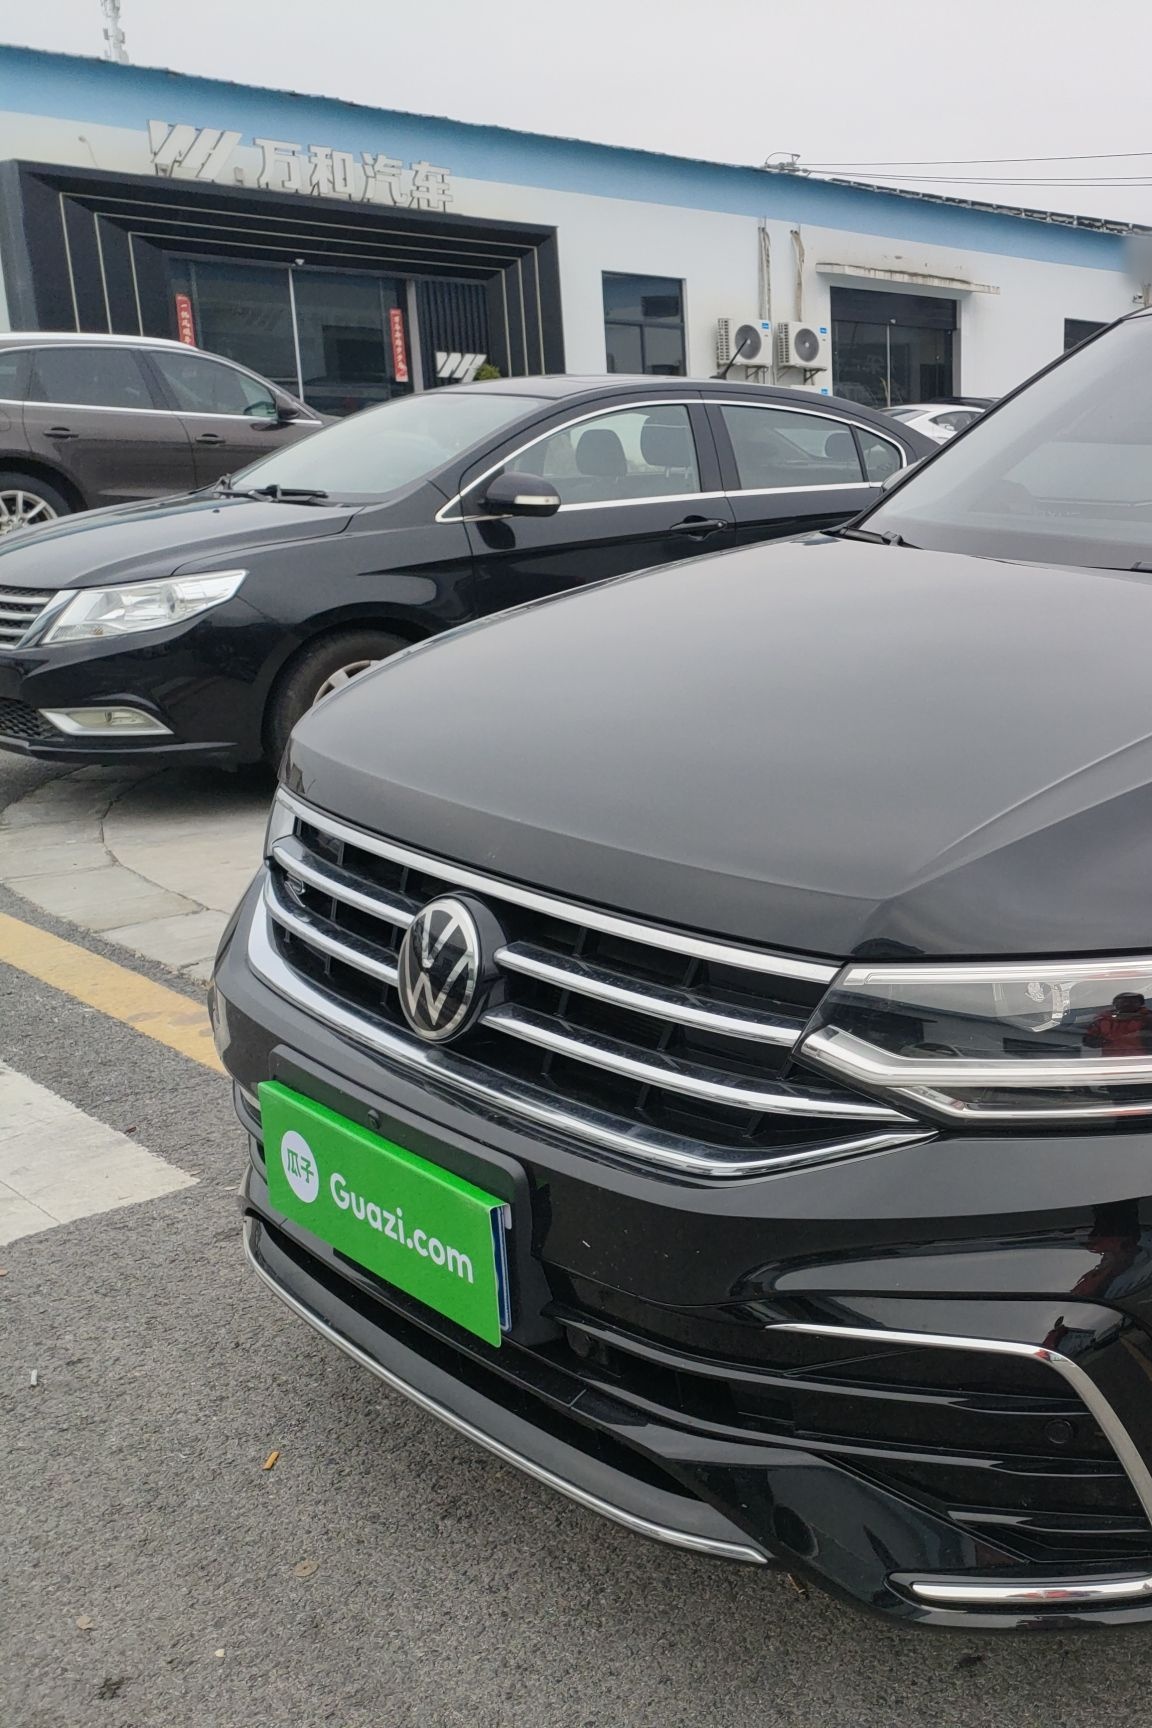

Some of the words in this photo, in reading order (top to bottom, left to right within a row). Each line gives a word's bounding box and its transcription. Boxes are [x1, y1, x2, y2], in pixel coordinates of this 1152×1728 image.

[253, 137, 453, 213] 万和汽车
[286, 1147, 315, 1184] 瓜子
[329, 1172, 475, 1285] Guazi.com
